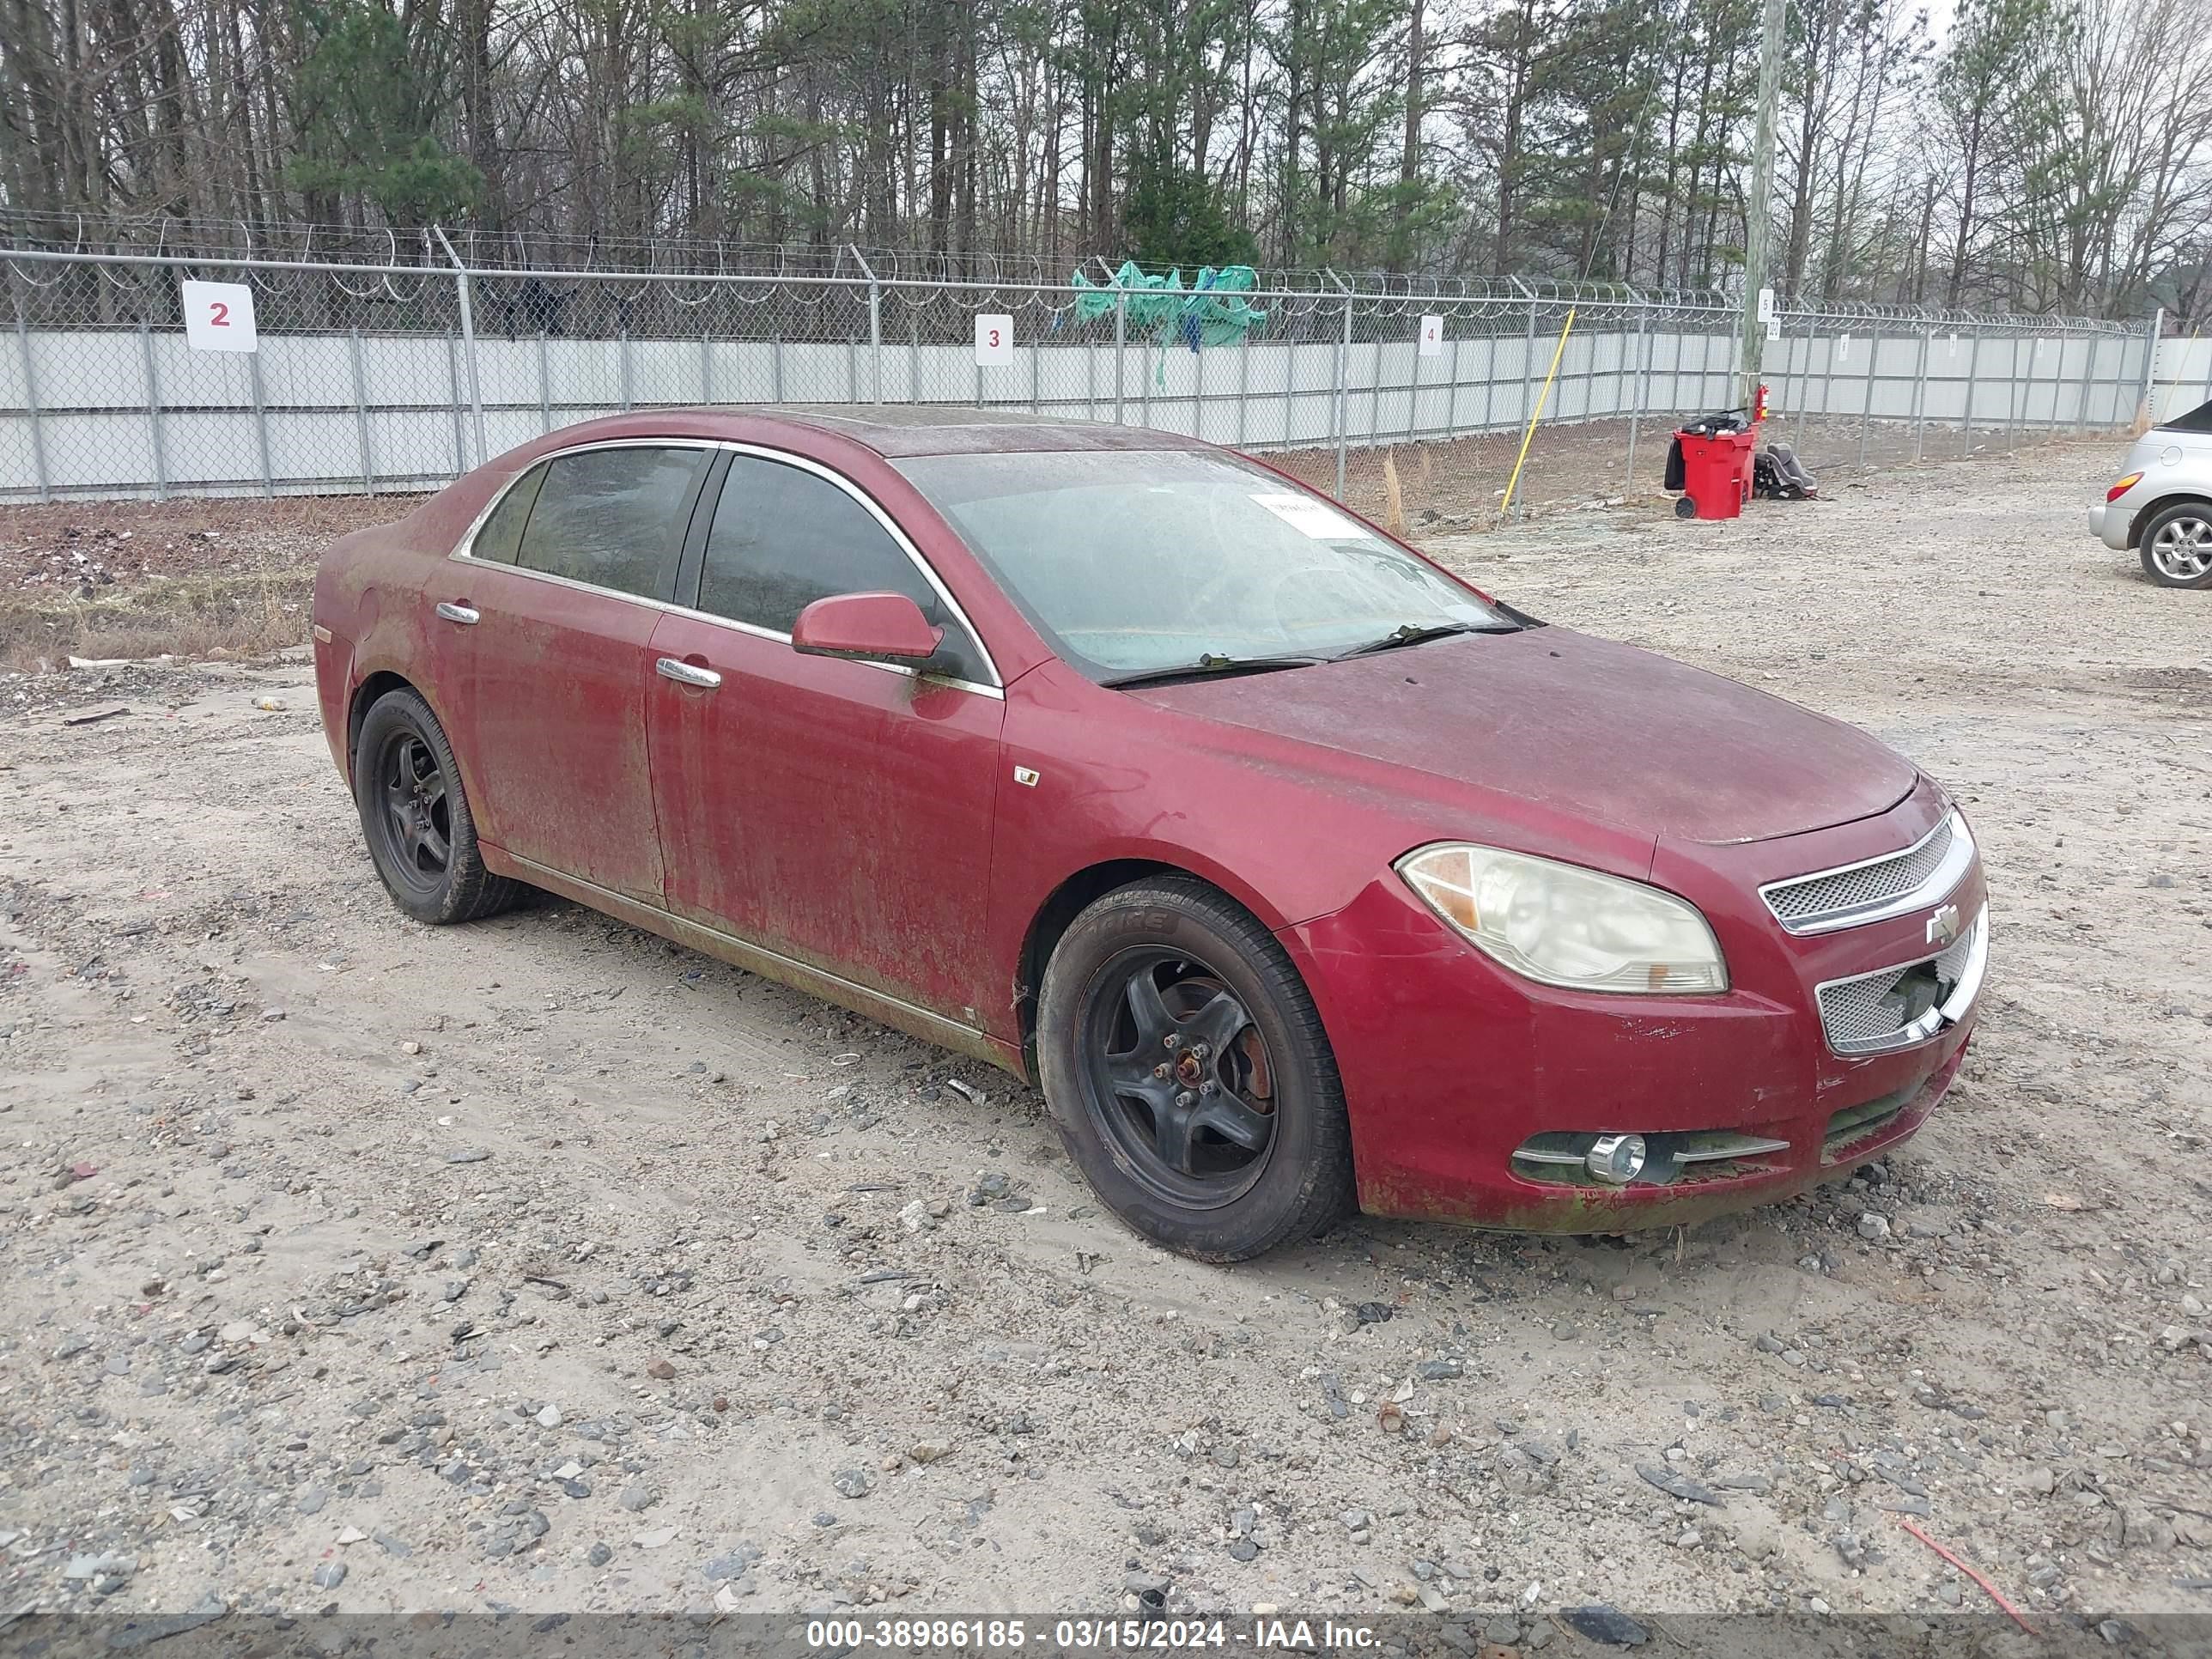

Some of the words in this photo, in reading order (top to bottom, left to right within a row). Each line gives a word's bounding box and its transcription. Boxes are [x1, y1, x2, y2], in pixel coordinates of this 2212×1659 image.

[1763, 299, 1768, 311] 5
[210, 302, 230, 326] 2
[988, 330, 1000, 348] 3
[1427, 328, 1434, 342] 4
